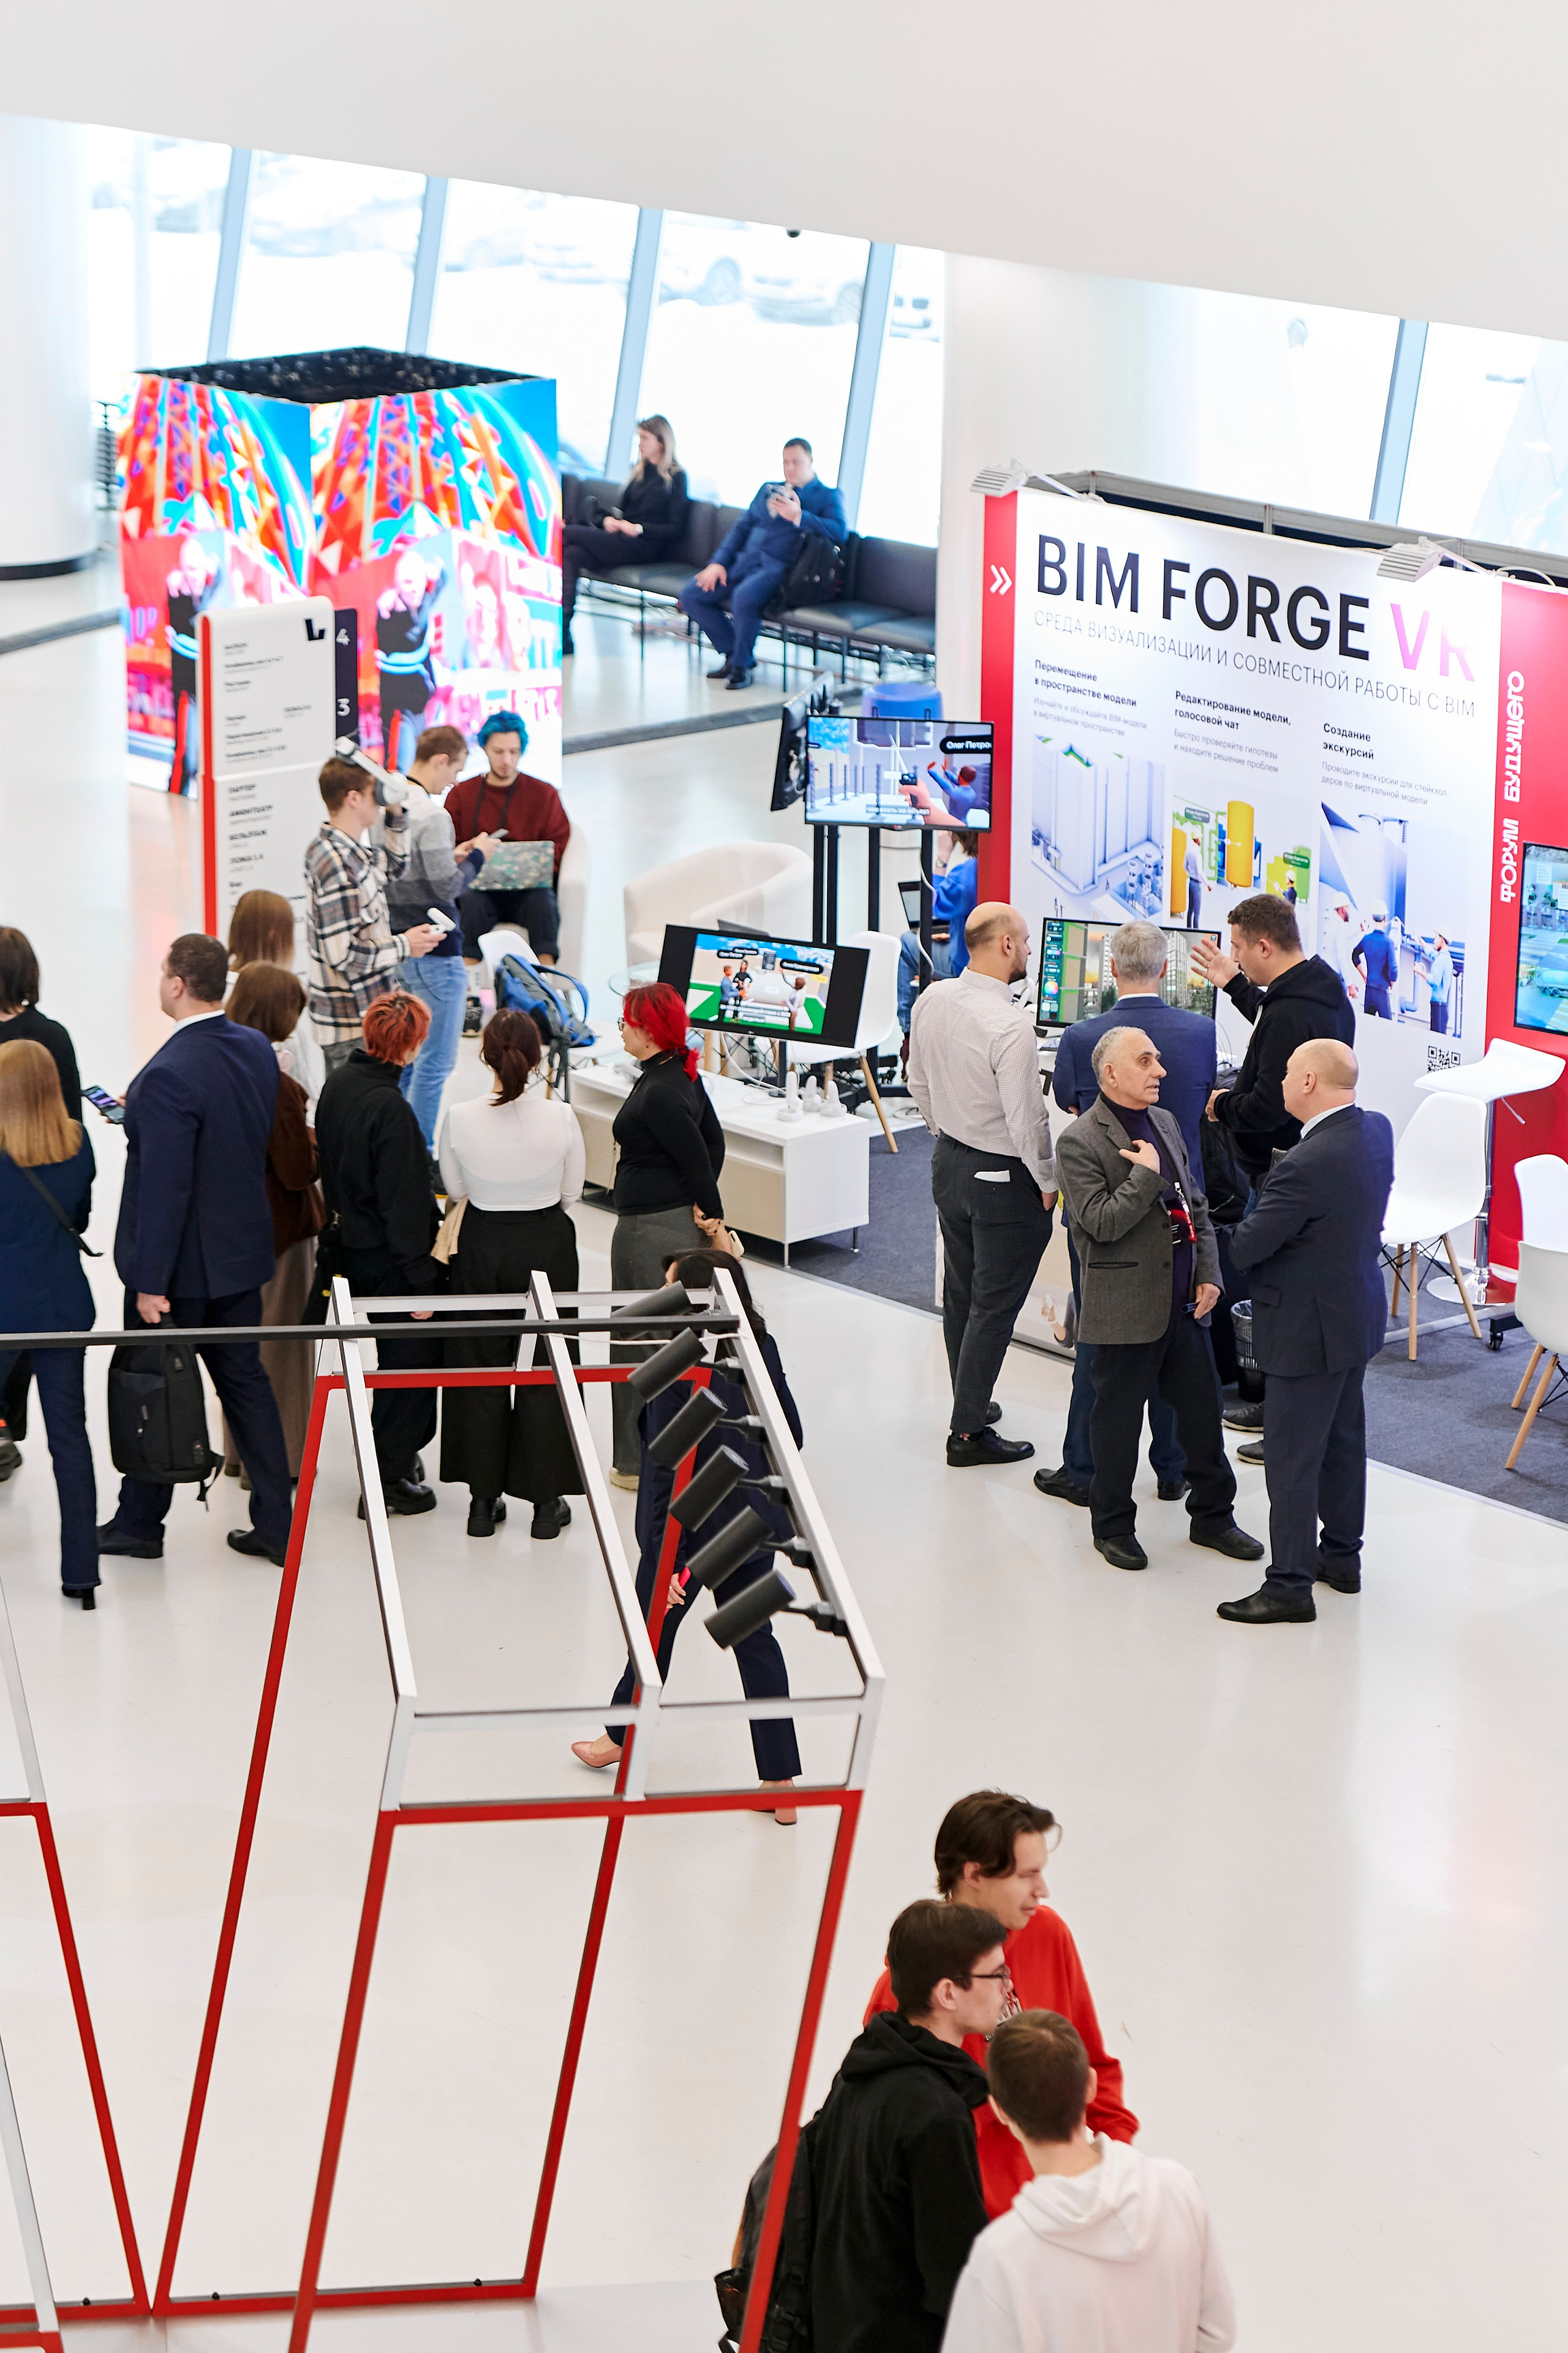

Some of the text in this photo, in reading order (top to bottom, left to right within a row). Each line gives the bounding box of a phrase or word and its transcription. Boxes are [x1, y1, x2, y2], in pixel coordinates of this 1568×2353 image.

[1038, 534, 1139, 613] BIM
[1163, 558, 1370, 661] FORGE
[336, 628, 350, 646] 4
[1035, 610, 1082, 634] СРЕДА
[1088, 621, 1212, 662] ВИЗУАЛИЗАЦИИ
[1217, 648, 1227, 666] И
[1233, 652, 1348, 692] СОВМЕСТНОЙ
[1355, 678, 1420, 706] РАБОТЫ
[1446, 697, 1475, 717] BIM
[1035, 659, 1097, 681] Перемещение
[337, 698, 350, 716] 3
[1041, 679, 1101, 698] пространстве
[1104, 693, 1137, 707] модели
[1175, 690, 1291, 726] Редактирование модели,
[1175, 709, 1240, 730] голосовой чат
[1039, 711, 1079, 726] виртуальном
[1080, 720, 1125, 736] пространстве
[1324, 723, 1371, 742] Создание
[1174, 728, 1278, 759] Быстро проверяйте гипотезы
[1323, 741, 1374, 760] экскурсий
[1180, 745, 1212, 758] находите
[1213, 752, 1246, 765] решение
[1247, 760, 1278, 773] проблем
[1321, 776, 1343, 787] деров
[1355, 783, 1400, 799] виртуальной
[1401, 793, 1428, 806] модели
[1322, 761, 1450, 796] Проводите экскурсии для стейкхол-
[1500, 818, 1519, 903] ФОРУМ
